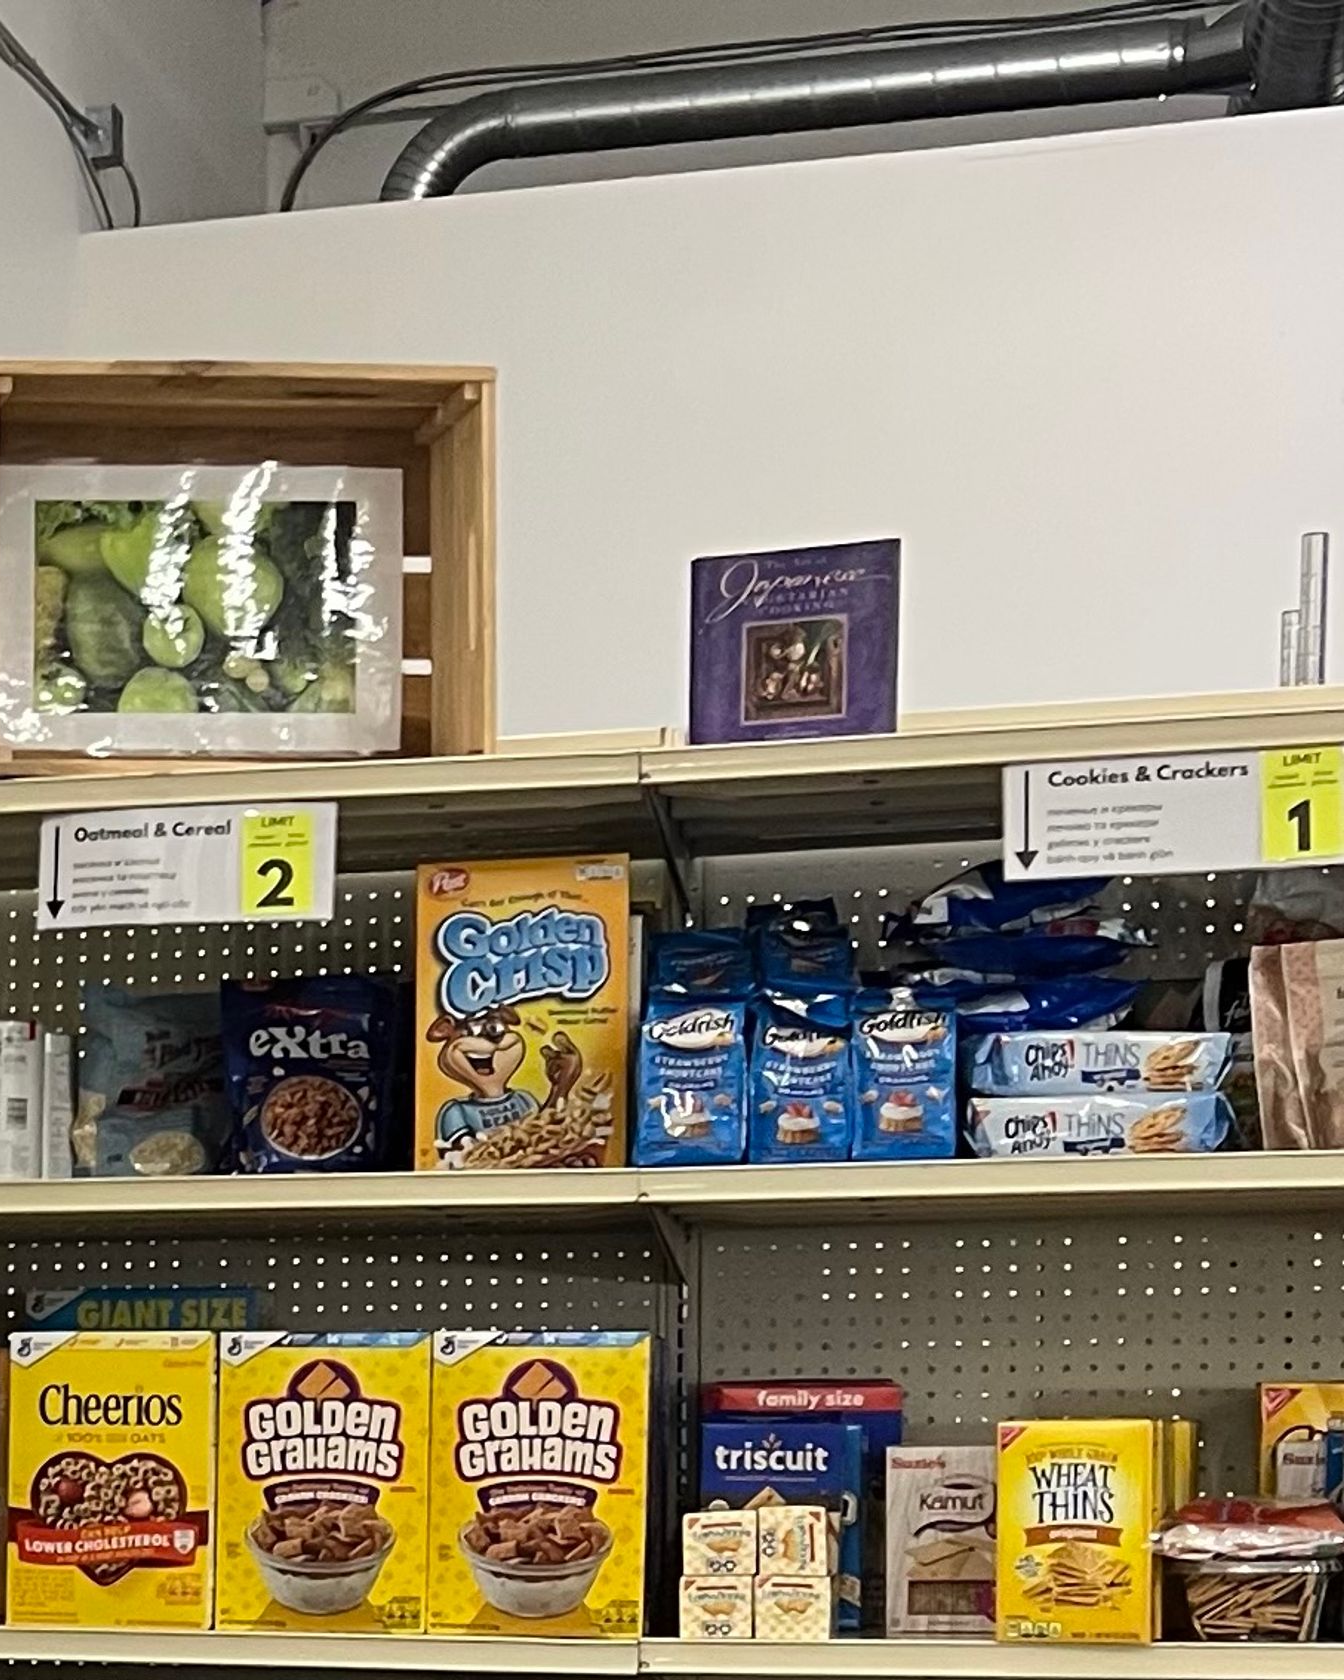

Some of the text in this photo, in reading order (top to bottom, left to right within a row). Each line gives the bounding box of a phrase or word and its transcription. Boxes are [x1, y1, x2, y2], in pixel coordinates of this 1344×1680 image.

[1283, 752, 1321, 767] LIMIT
[1048, 763, 1249, 788] Cookies & Crackers
[74, 820, 232, 843] Oatmeal & Cereal
[1288, 799, 1311, 851] 1
[256, 858, 295, 908] 2
[444, 912, 603, 958] Golden
[446, 946, 604, 1013] Crisp
[861, 1011, 946, 1035] Goldfish
[77, 1297, 246, 1329] GIANT SIZE
[39, 1383, 184, 1427] Cheerios
[757, 1389, 864, 1411] family size
[714, 1442, 829, 1472] triscuit
[1028, 1463, 1116, 1491] WHEAT
[918, 1491, 985, 1512] Kamut
[24, 1533, 171, 1554] LOWER CHOLESTEROL
